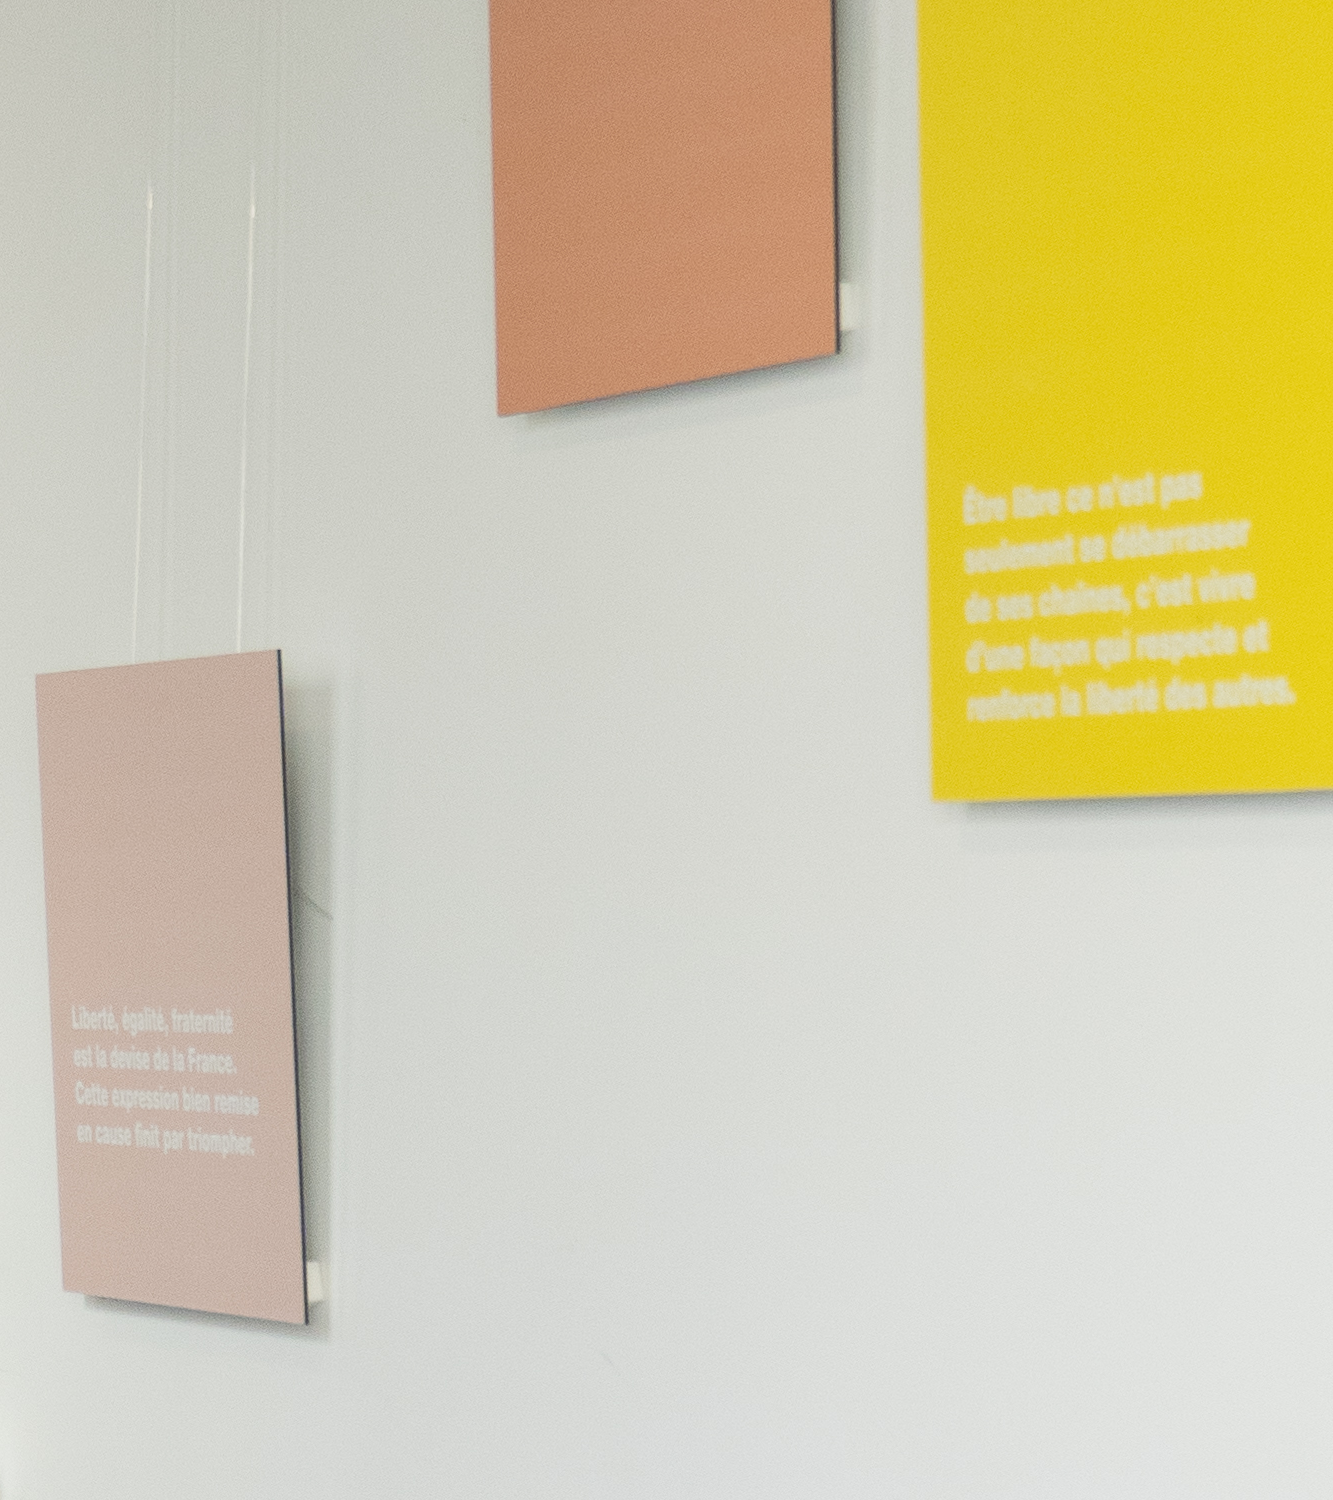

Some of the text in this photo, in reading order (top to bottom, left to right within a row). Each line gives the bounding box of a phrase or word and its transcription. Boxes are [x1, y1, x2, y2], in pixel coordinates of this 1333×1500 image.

[73, 1005, 232, 1037] Liberté, égalité, fraternité
[73, 1044, 234, 1075] est la devise de la France.
[75, 1080, 258, 1116] Cette expression bien remise
[78, 1122, 253, 1158] en cause finit par triompher.
